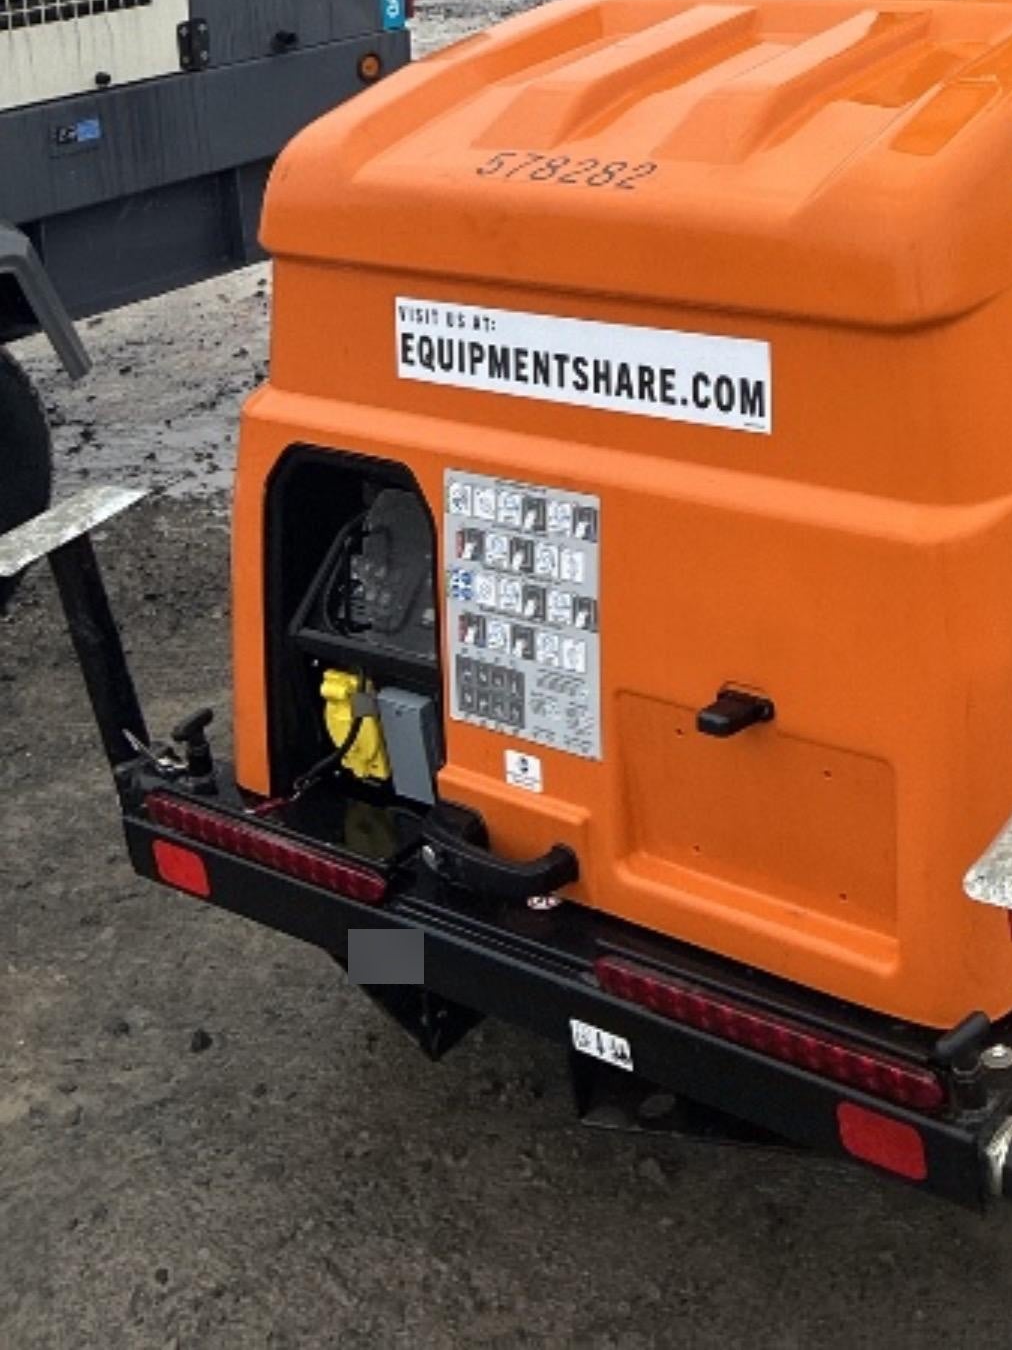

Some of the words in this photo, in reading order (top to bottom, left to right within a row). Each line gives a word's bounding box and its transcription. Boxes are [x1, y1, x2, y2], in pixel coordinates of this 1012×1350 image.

[475, 152, 658, 190] 578282
[398, 305, 439, 325] VISIT
[446, 311, 466, 328] US
[473, 314, 496, 333] AT:
[400, 332, 765, 418] EQUIPMENTSHARE.COM
